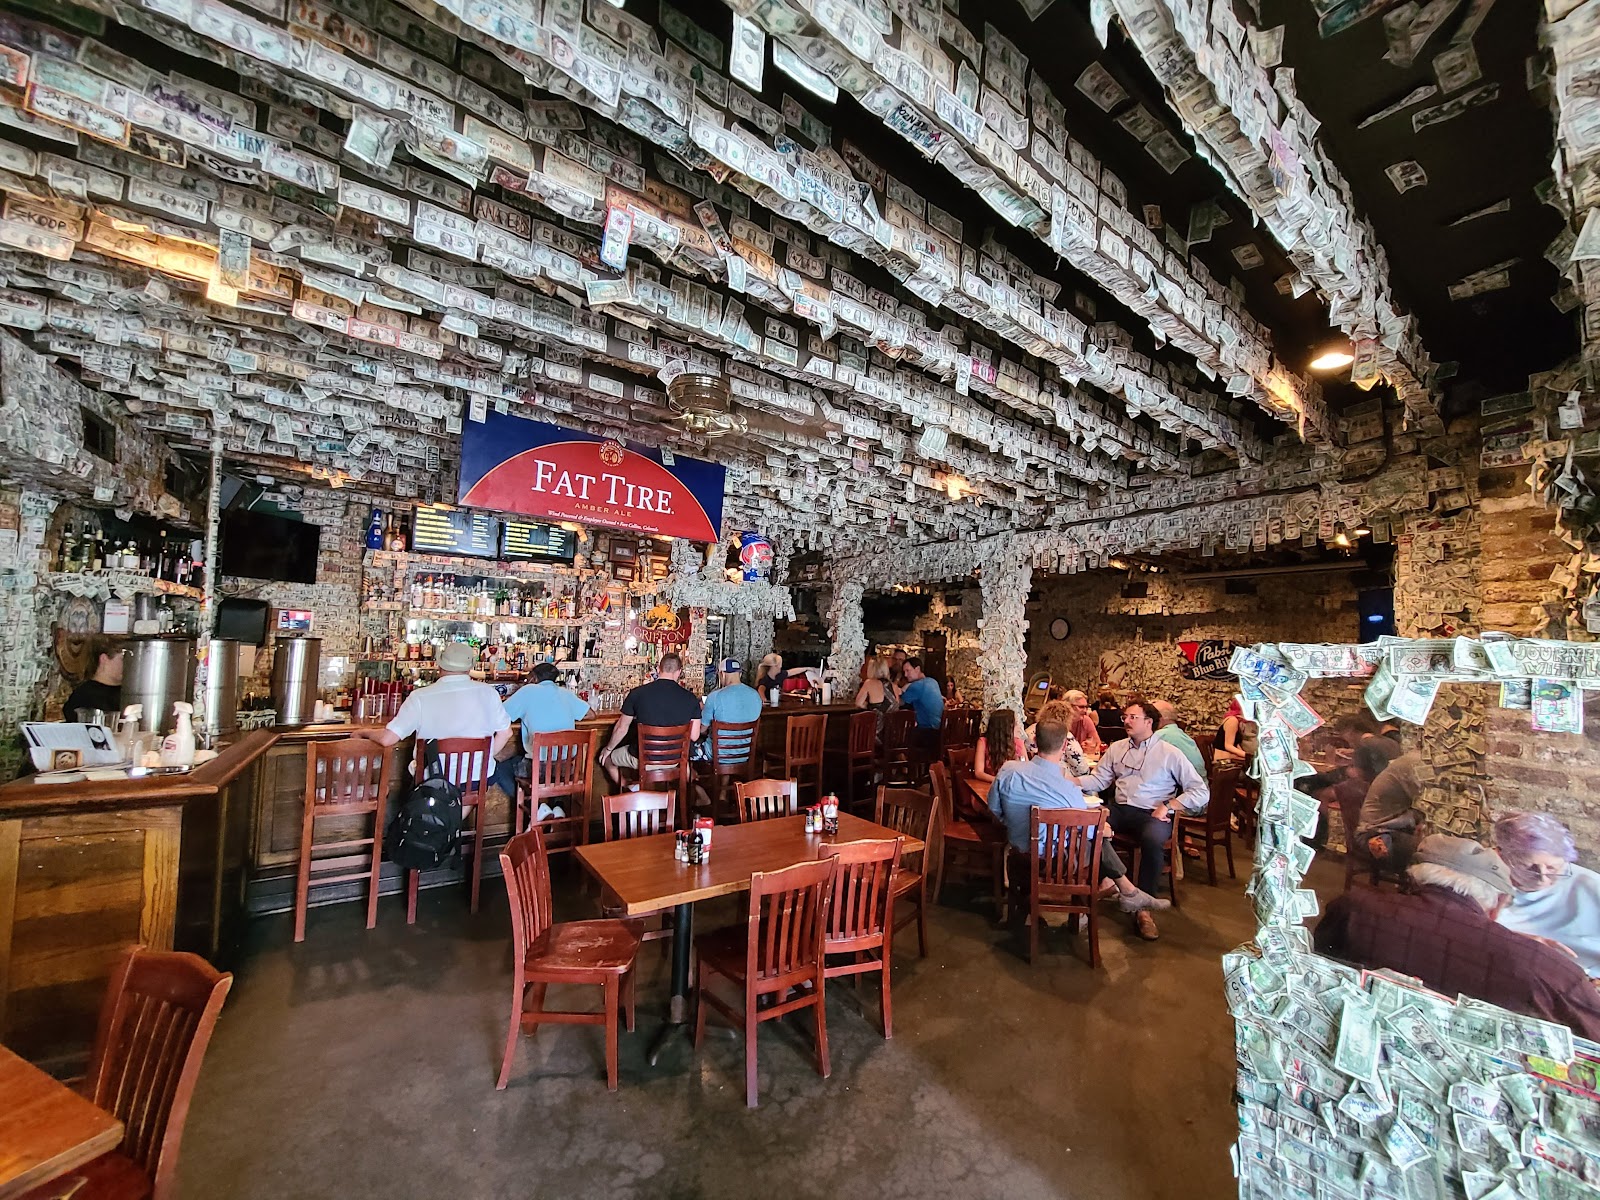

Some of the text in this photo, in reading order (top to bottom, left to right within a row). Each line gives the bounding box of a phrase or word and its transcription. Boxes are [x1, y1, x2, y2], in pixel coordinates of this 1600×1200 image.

[531, 459, 596, 500] FAT
[575, 503, 632, 518] AMBER ALE
[633, 626, 686, 643] GRIFFON
[1192, 663, 1215, 678] Blue
